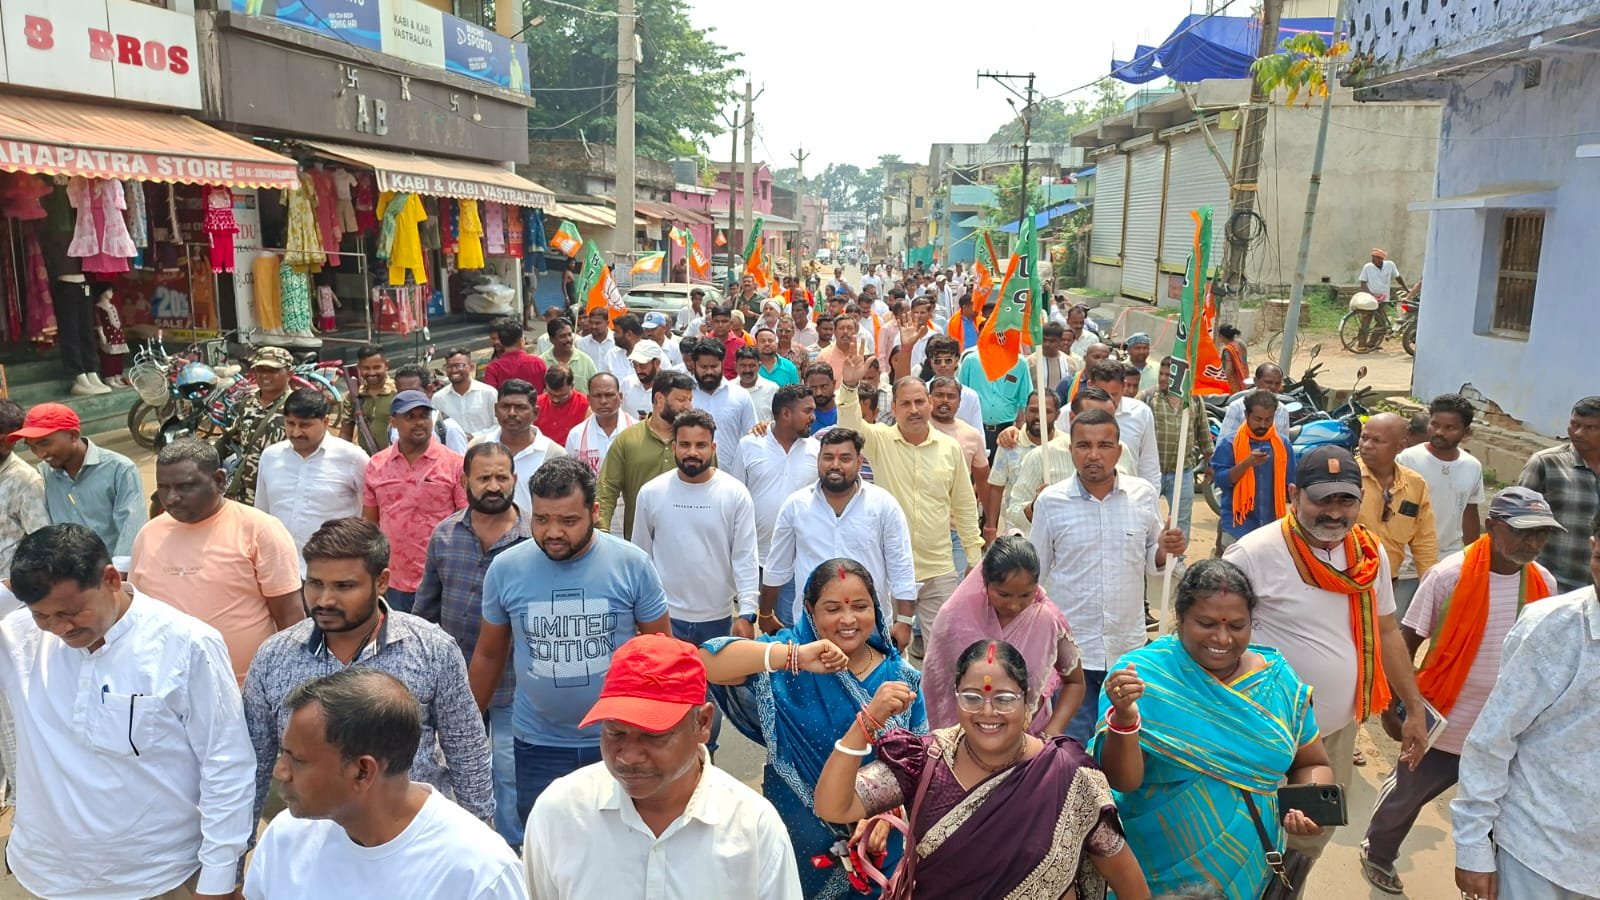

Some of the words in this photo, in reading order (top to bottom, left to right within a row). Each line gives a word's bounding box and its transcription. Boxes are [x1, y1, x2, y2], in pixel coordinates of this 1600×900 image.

[393, 14, 409, 28] KABI
[416, 22, 430, 34] KABI
[393, 27, 432, 48] VASTRALAYA
[467, 33, 493, 54] SPORTO
[88, 27, 189, 75] BROS
[156, 156, 234, 179] STORE
[391, 174, 429, 190] KABI
[434, 180, 444, 191] &
[448, 180, 479, 195] KABI
[481, 185, 546, 205] VASTRALAYA
[520, 612, 618, 639] LIMITED
[526, 633, 616, 662] EDITION
